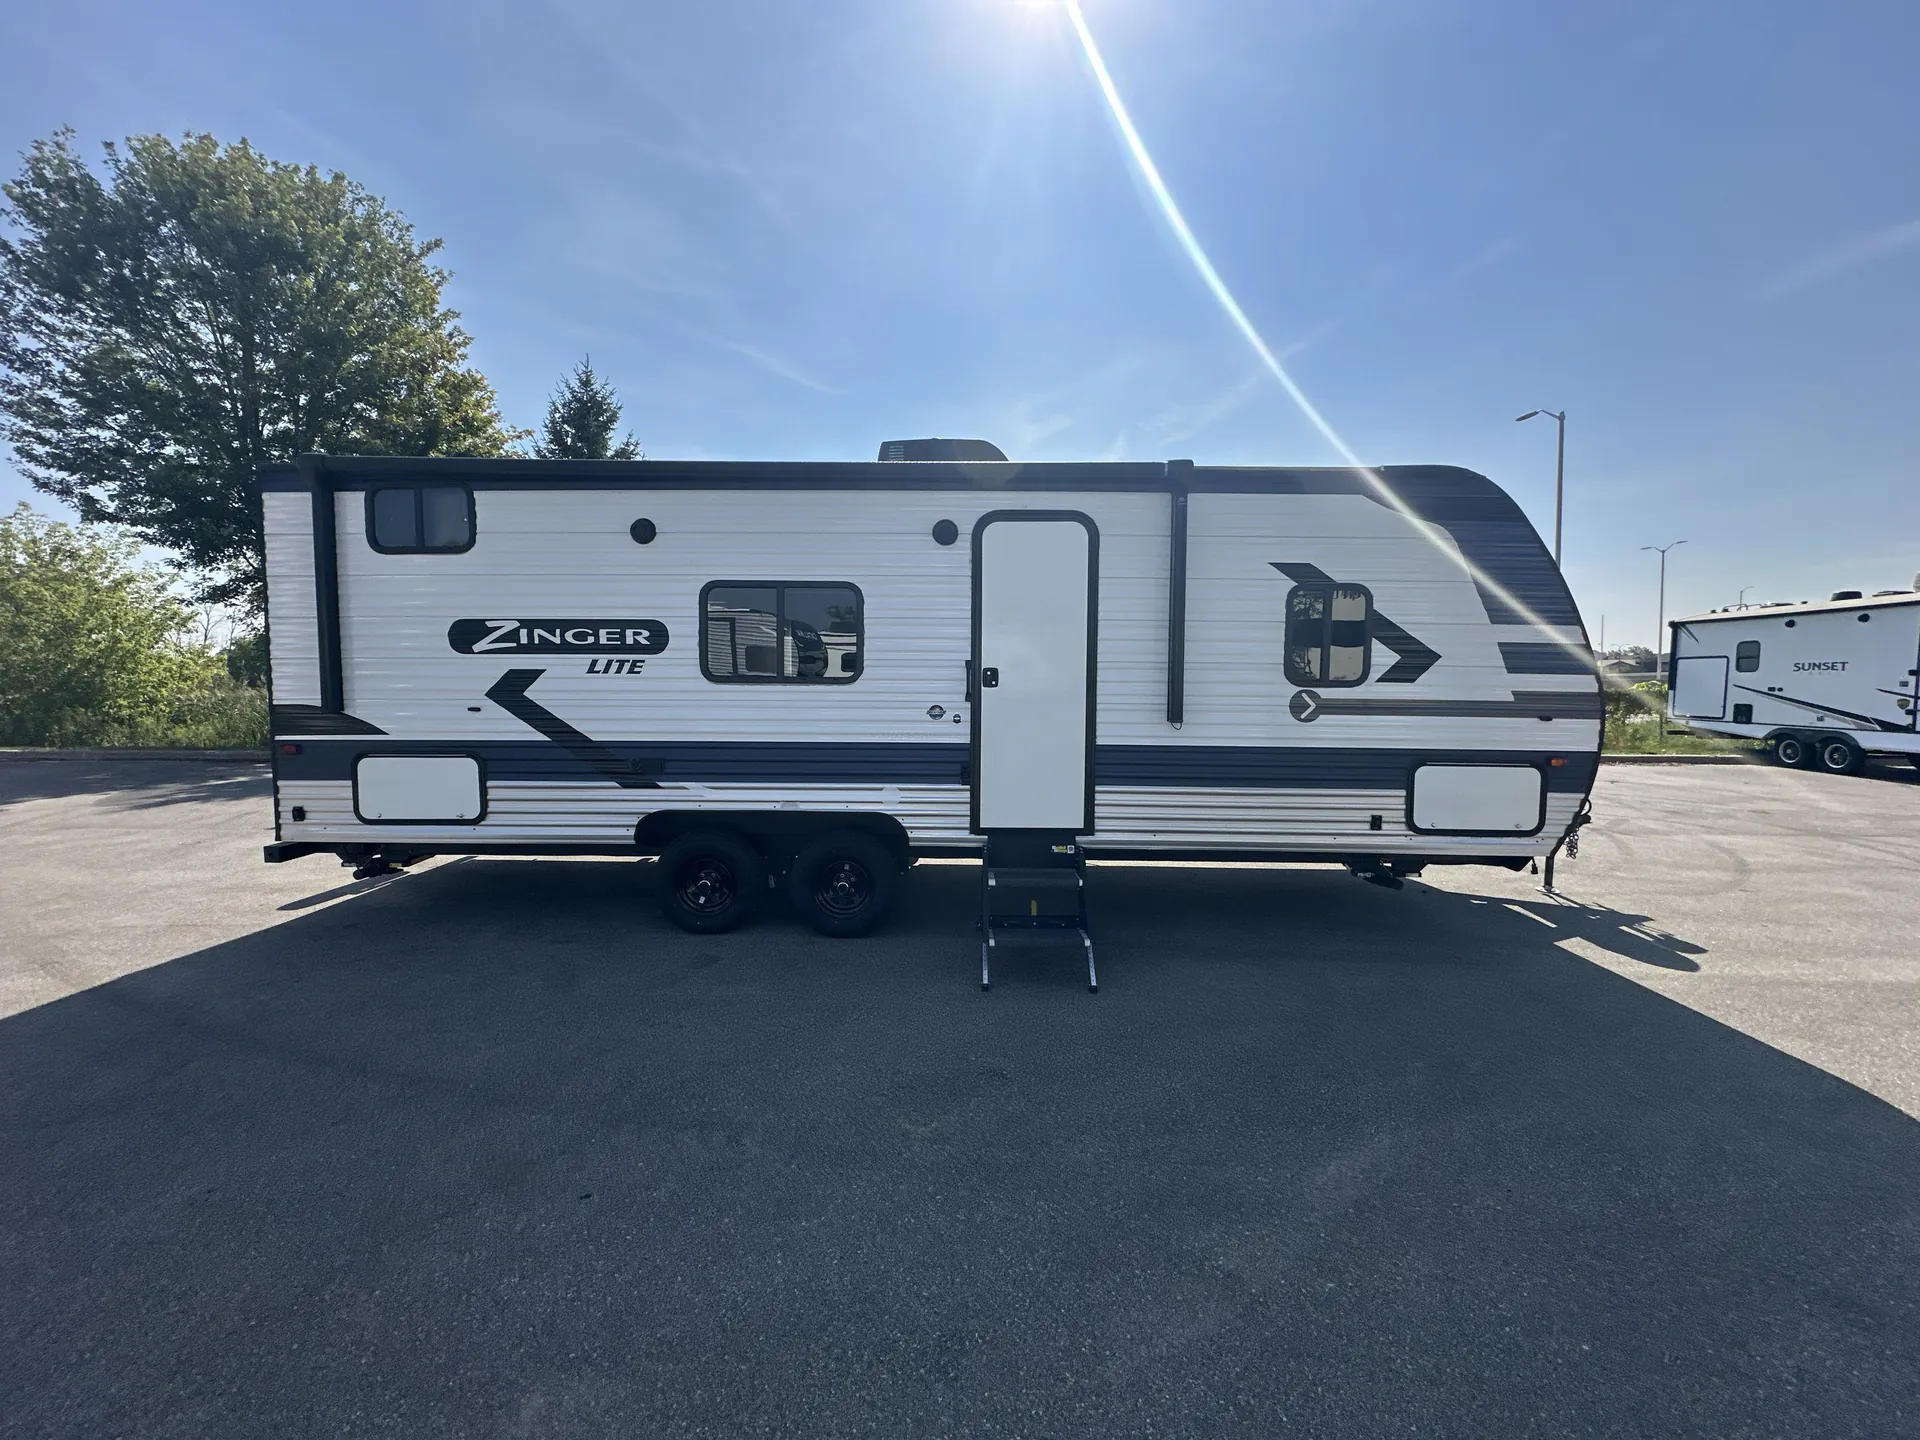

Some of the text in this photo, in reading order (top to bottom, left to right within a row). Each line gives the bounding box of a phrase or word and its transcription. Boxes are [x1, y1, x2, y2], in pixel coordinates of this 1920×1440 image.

[471, 620, 651, 653] ZINGER
[585, 659, 646, 675] LITE
[1792, 661, 1849, 672] SUNSET
